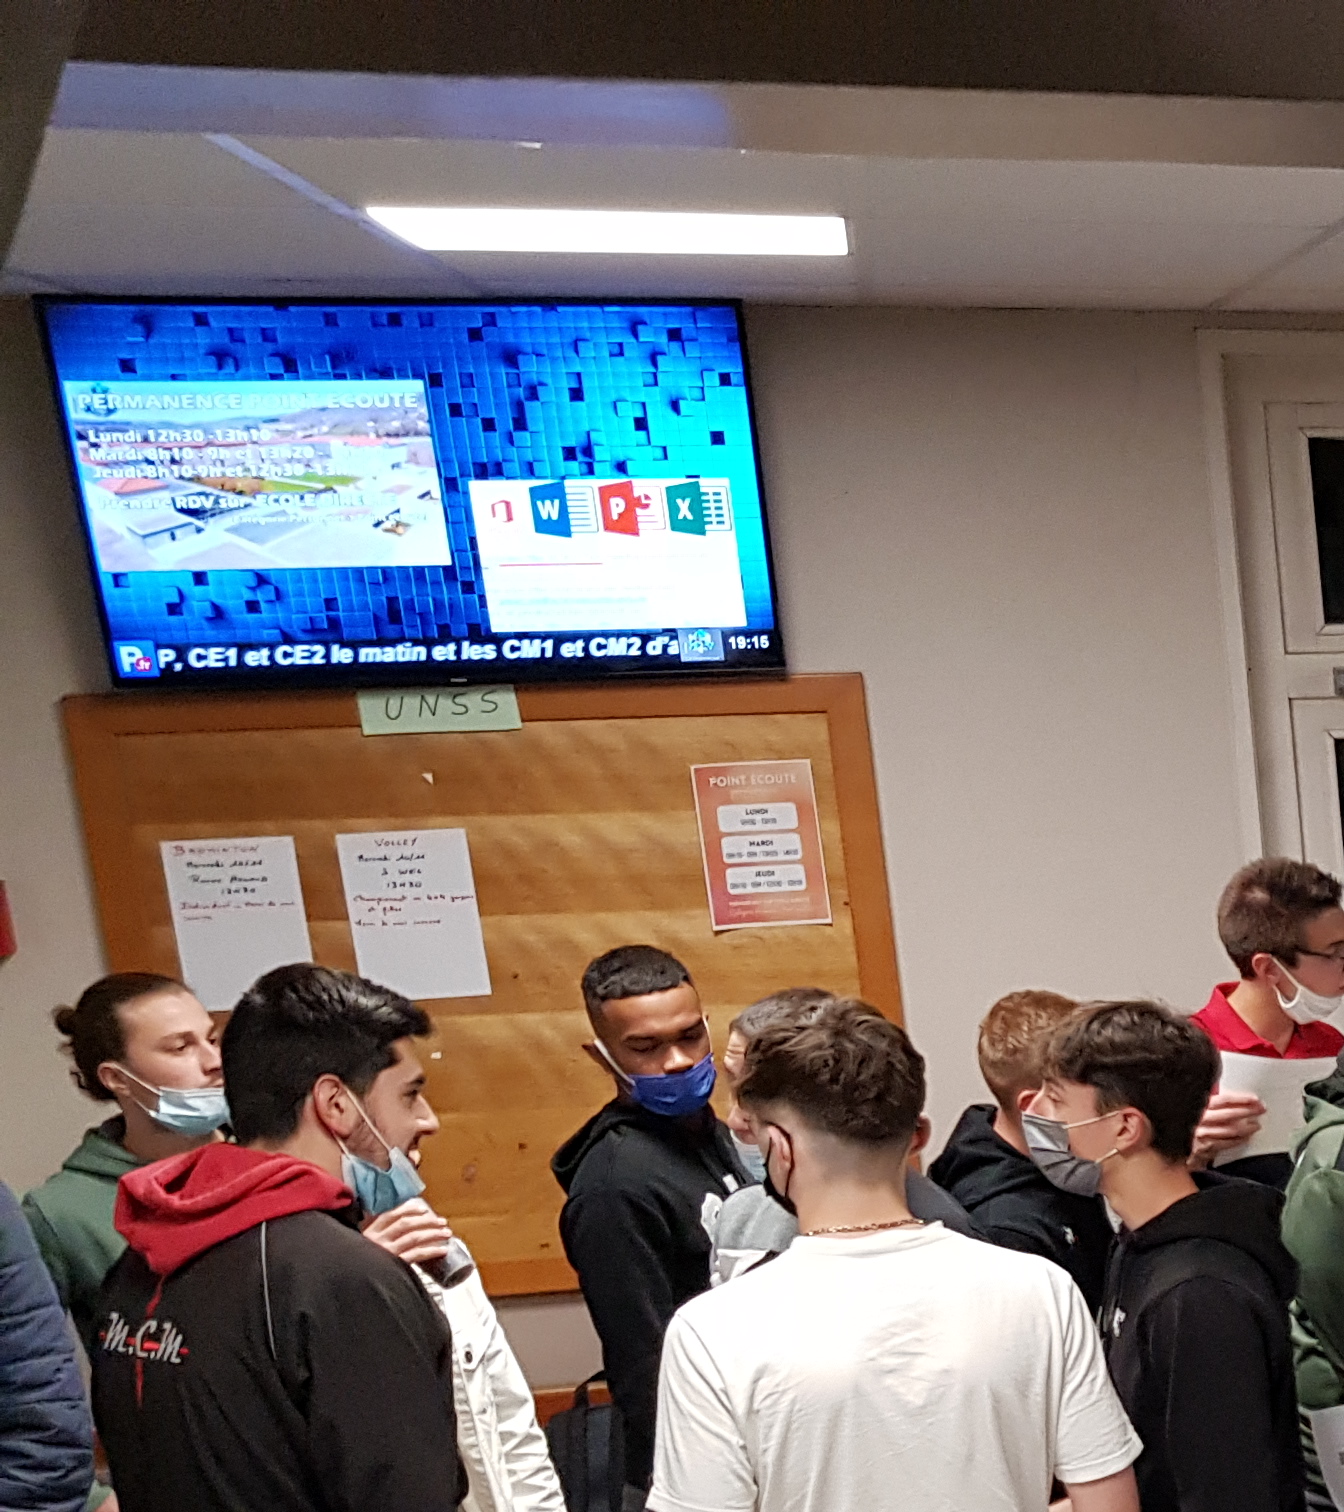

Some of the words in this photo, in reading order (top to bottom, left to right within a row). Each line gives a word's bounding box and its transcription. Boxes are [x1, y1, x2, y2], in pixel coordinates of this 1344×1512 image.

[77, 393, 243, 410] PERMANENCE
[326, 391, 418, 409] ECOUTE
[88, 429, 142, 443] Lundi
[147, 429, 204, 443] 12h30
[88, 447, 143, 461] Mardi
[93, 465, 143, 479] Jeudi
[175, 495, 214, 509] RDV
[219, 497, 247, 509] sur
[255, 493, 317, 507] ECOLE
[188, 646, 239, 668] CE1
[244, 647, 271, 666] et
[274, 644, 326, 665] CE2
[331, 643, 354, 664] le
[358, 641, 427, 663] matin
[431, 640, 457, 661] et
[461, 639, 497, 660] les
[502, 638, 554, 659] CM1
[560, 638, 585, 658] et
[589, 636, 642, 657] CM2
[385, 690, 499, 721] UNSS
[709, 776, 748, 787] POINT
[374, 836, 418, 847] VOLLEY
